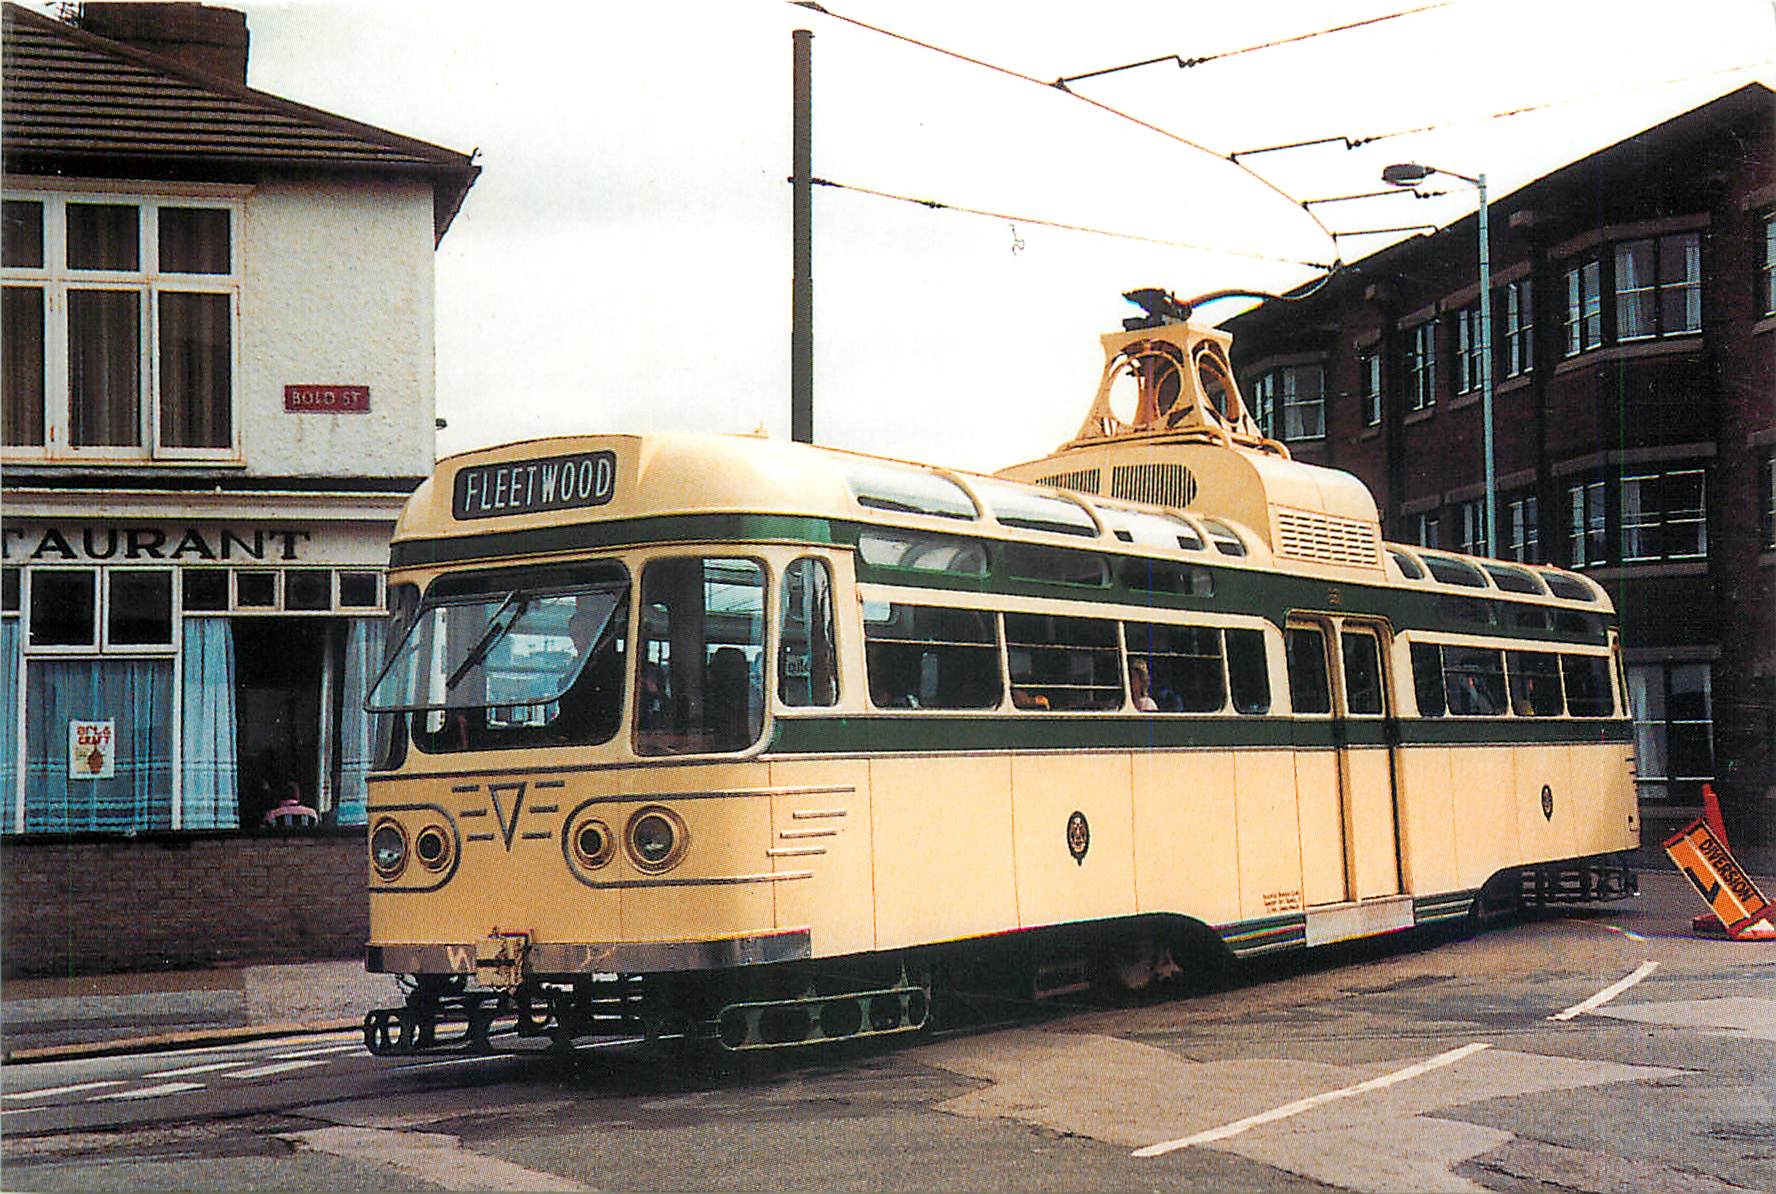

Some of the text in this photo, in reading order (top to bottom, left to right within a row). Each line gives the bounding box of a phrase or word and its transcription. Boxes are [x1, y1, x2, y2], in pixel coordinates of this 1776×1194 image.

[292, 391, 361, 406] BOLD ST
[465, 458, 611, 512] FLEETWOOD
[1699, 838, 1754, 903] DIVERSION
